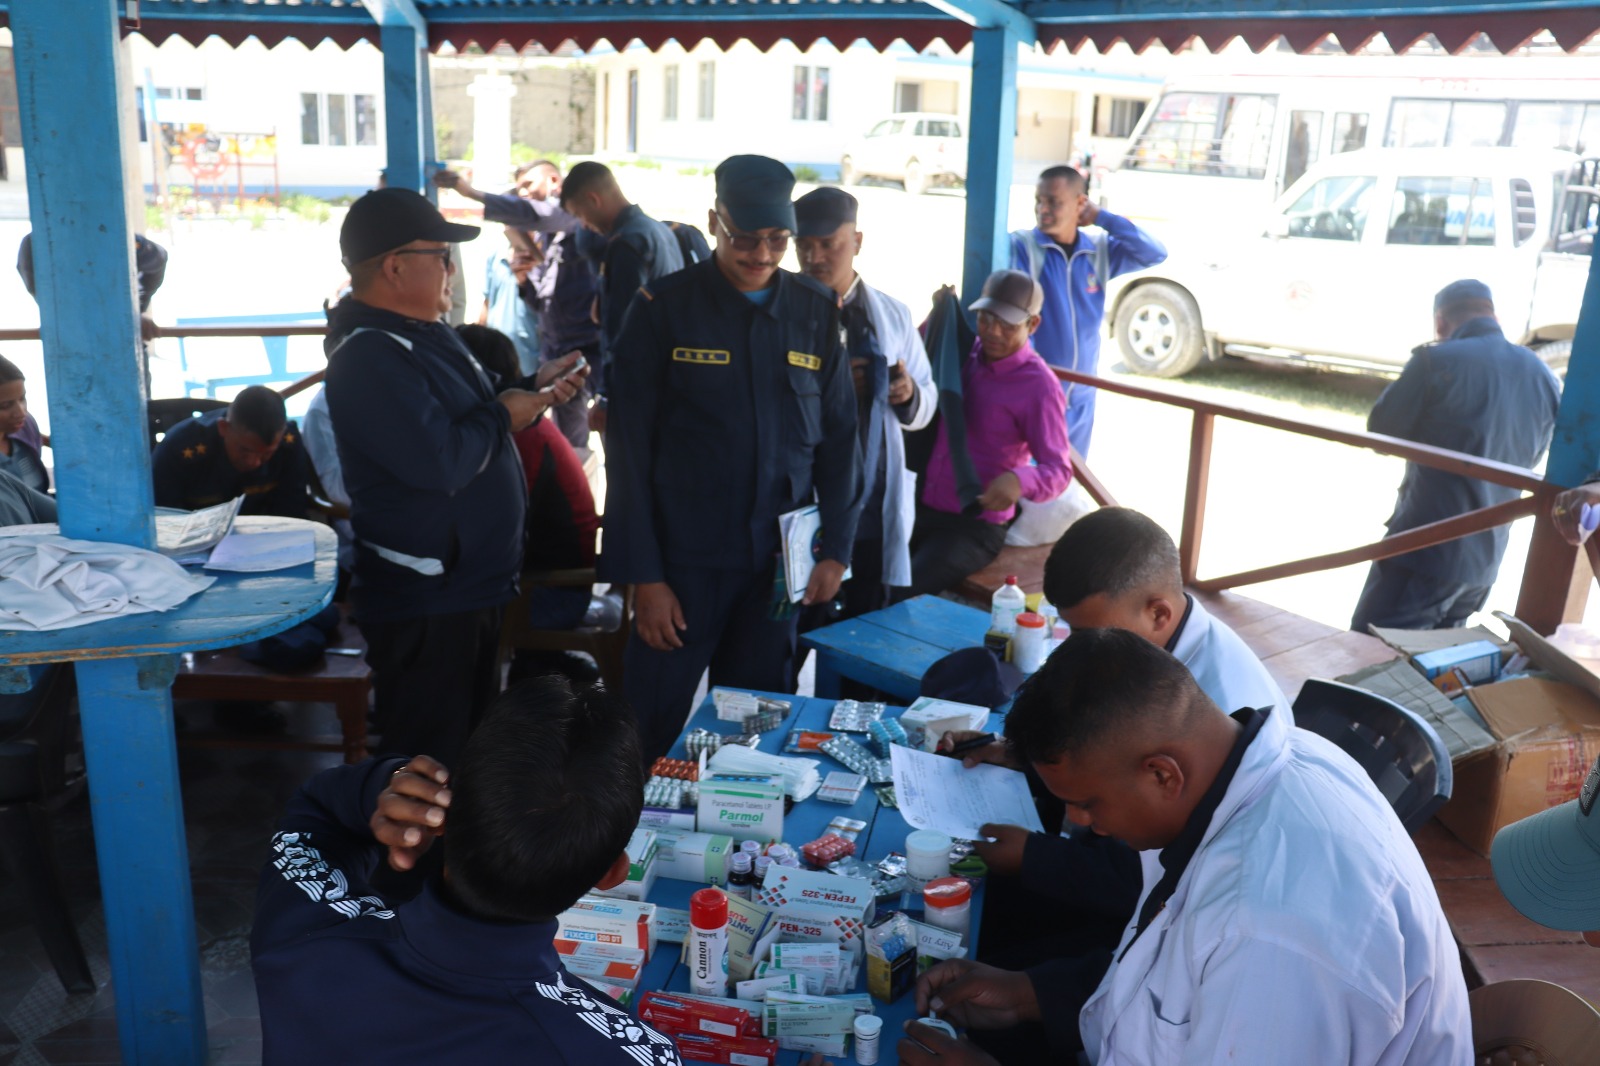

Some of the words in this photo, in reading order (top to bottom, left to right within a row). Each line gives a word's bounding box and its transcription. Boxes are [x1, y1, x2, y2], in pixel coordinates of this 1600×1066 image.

[719, 809, 764, 822] Parmol
[802, 889, 857, 904] FEPEN-325
[564, 930, 596, 941] FIXCEF
[598, 933, 611, 943] 200
[611, 935, 622, 944] DT
[922, 935, 932, 944] 10
[934, 938, 953, 950] Airy
[697, 941, 707, 980] Cannon
